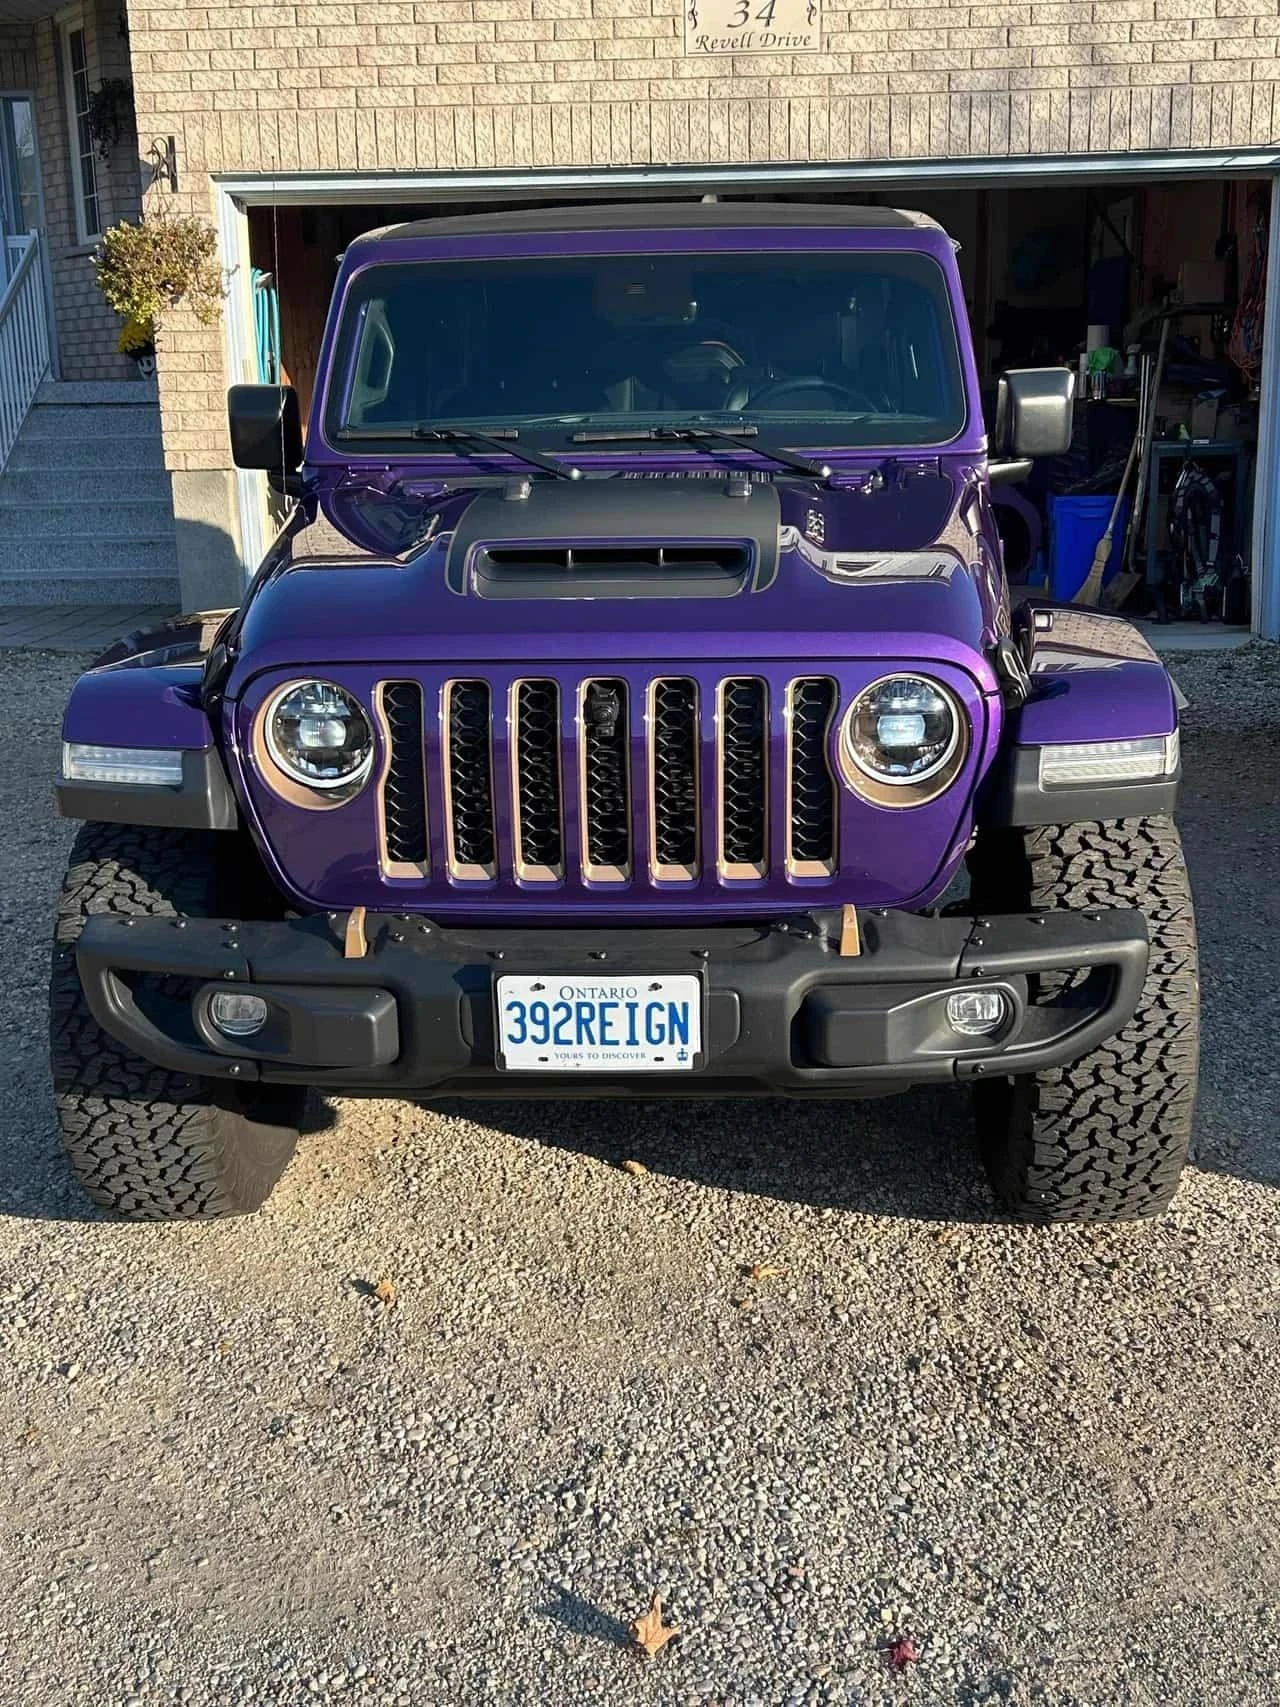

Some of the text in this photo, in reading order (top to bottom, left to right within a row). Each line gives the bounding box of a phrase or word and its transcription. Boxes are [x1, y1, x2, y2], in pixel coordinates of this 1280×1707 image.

[727, 0, 776, 28] 34
[696, 32, 811, 53] Revell Drive
[559, 985, 638, 1001] ONTARIO
[505, 1000, 689, 1046] 392REIGN
[554, 1051, 646, 1060] YOURS TO DISCOVER
